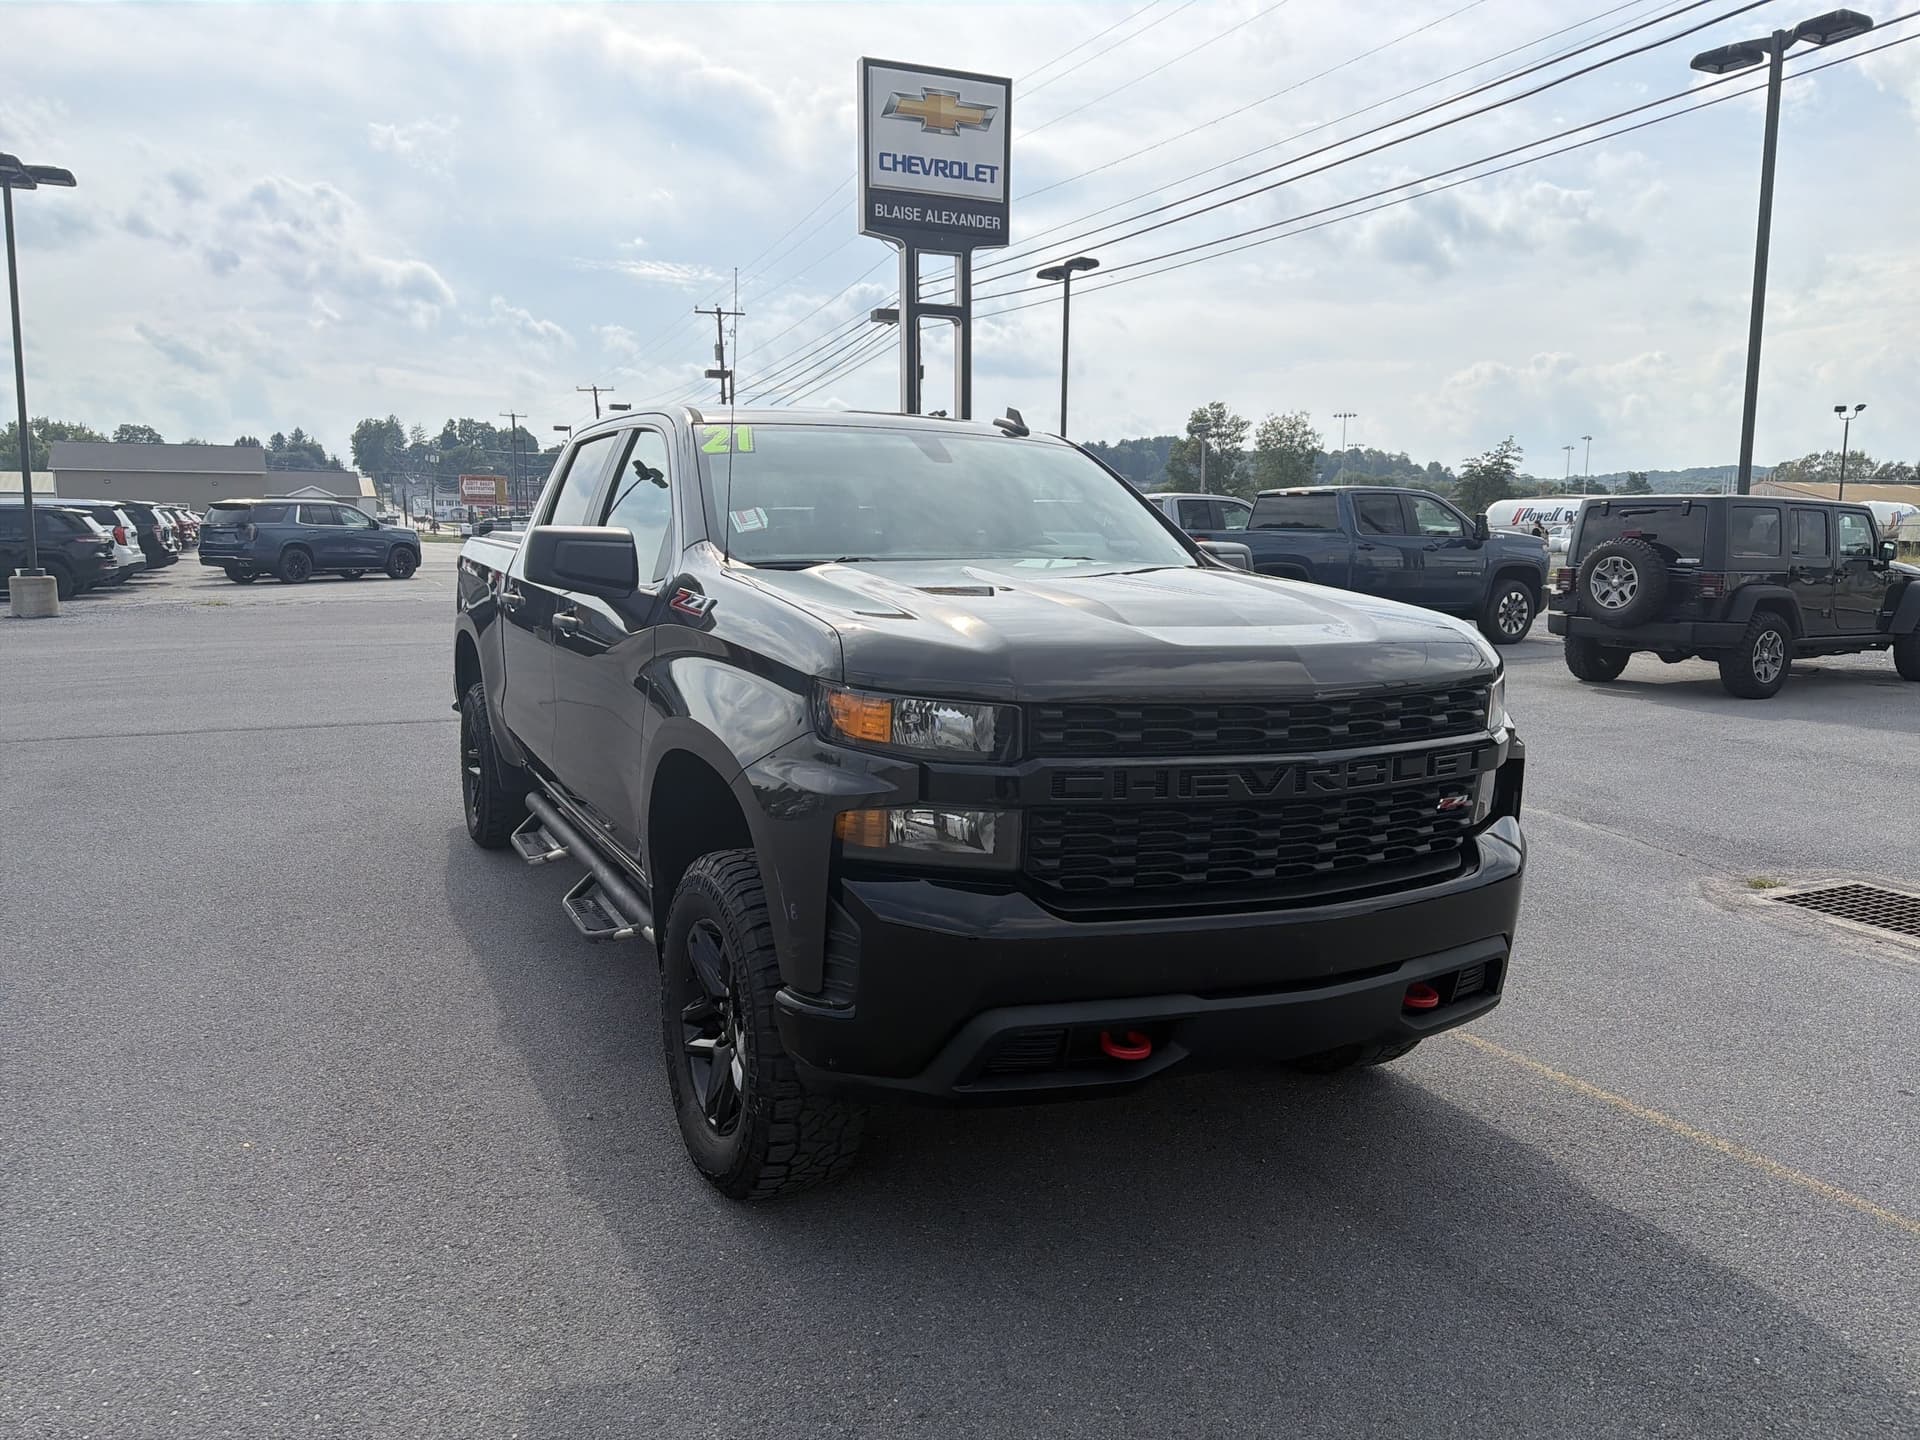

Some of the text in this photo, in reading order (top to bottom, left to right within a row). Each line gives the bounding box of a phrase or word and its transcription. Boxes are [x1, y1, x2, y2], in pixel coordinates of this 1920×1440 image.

[879, 152, 998, 183] CHEVROLET
[875, 203, 1001, 230] BLAISE ALEXANDER
[701, 425, 755, 454] 21
[1521, 507, 1564, 522] Powell
[669, 587, 718, 618] Z71
[1049, 748, 1489, 800] CHEVROLET
